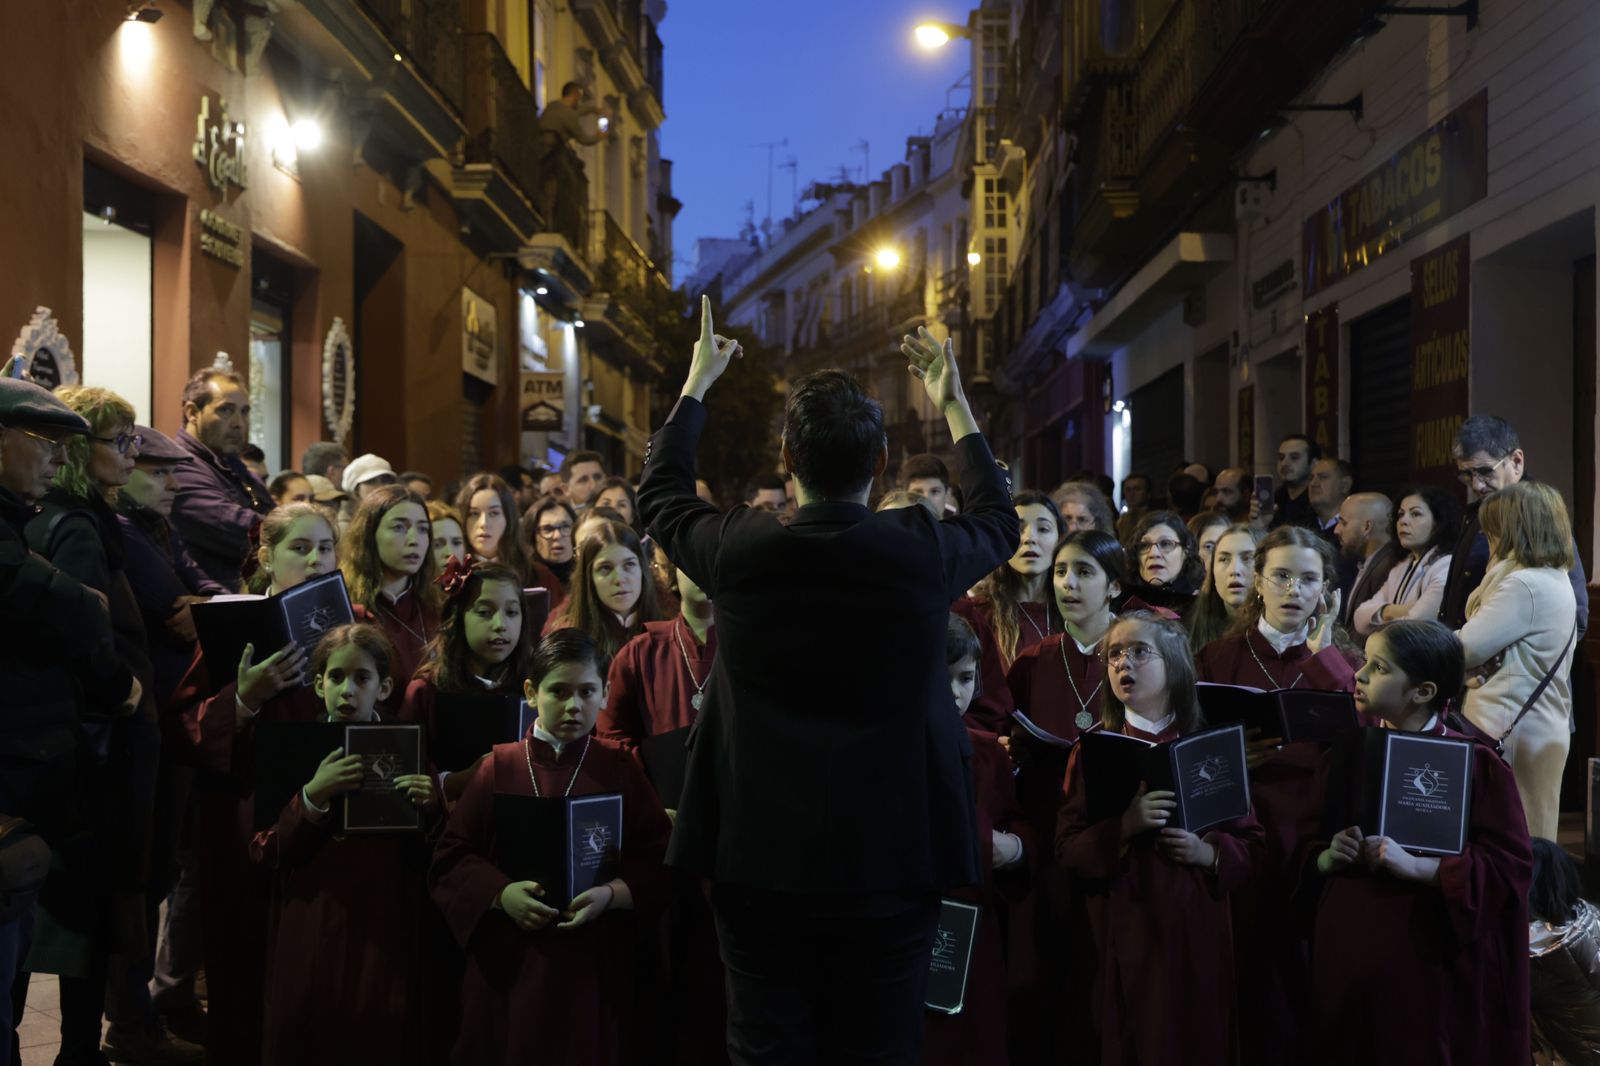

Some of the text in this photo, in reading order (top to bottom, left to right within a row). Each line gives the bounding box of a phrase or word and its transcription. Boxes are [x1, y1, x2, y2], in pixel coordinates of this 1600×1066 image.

[1348, 134, 1441, 239] TABACOS
[1423, 248, 1459, 309] SELLOS
[524, 379, 563, 394] ATM
[1414, 328, 1468, 391] ARTÍCULOS
